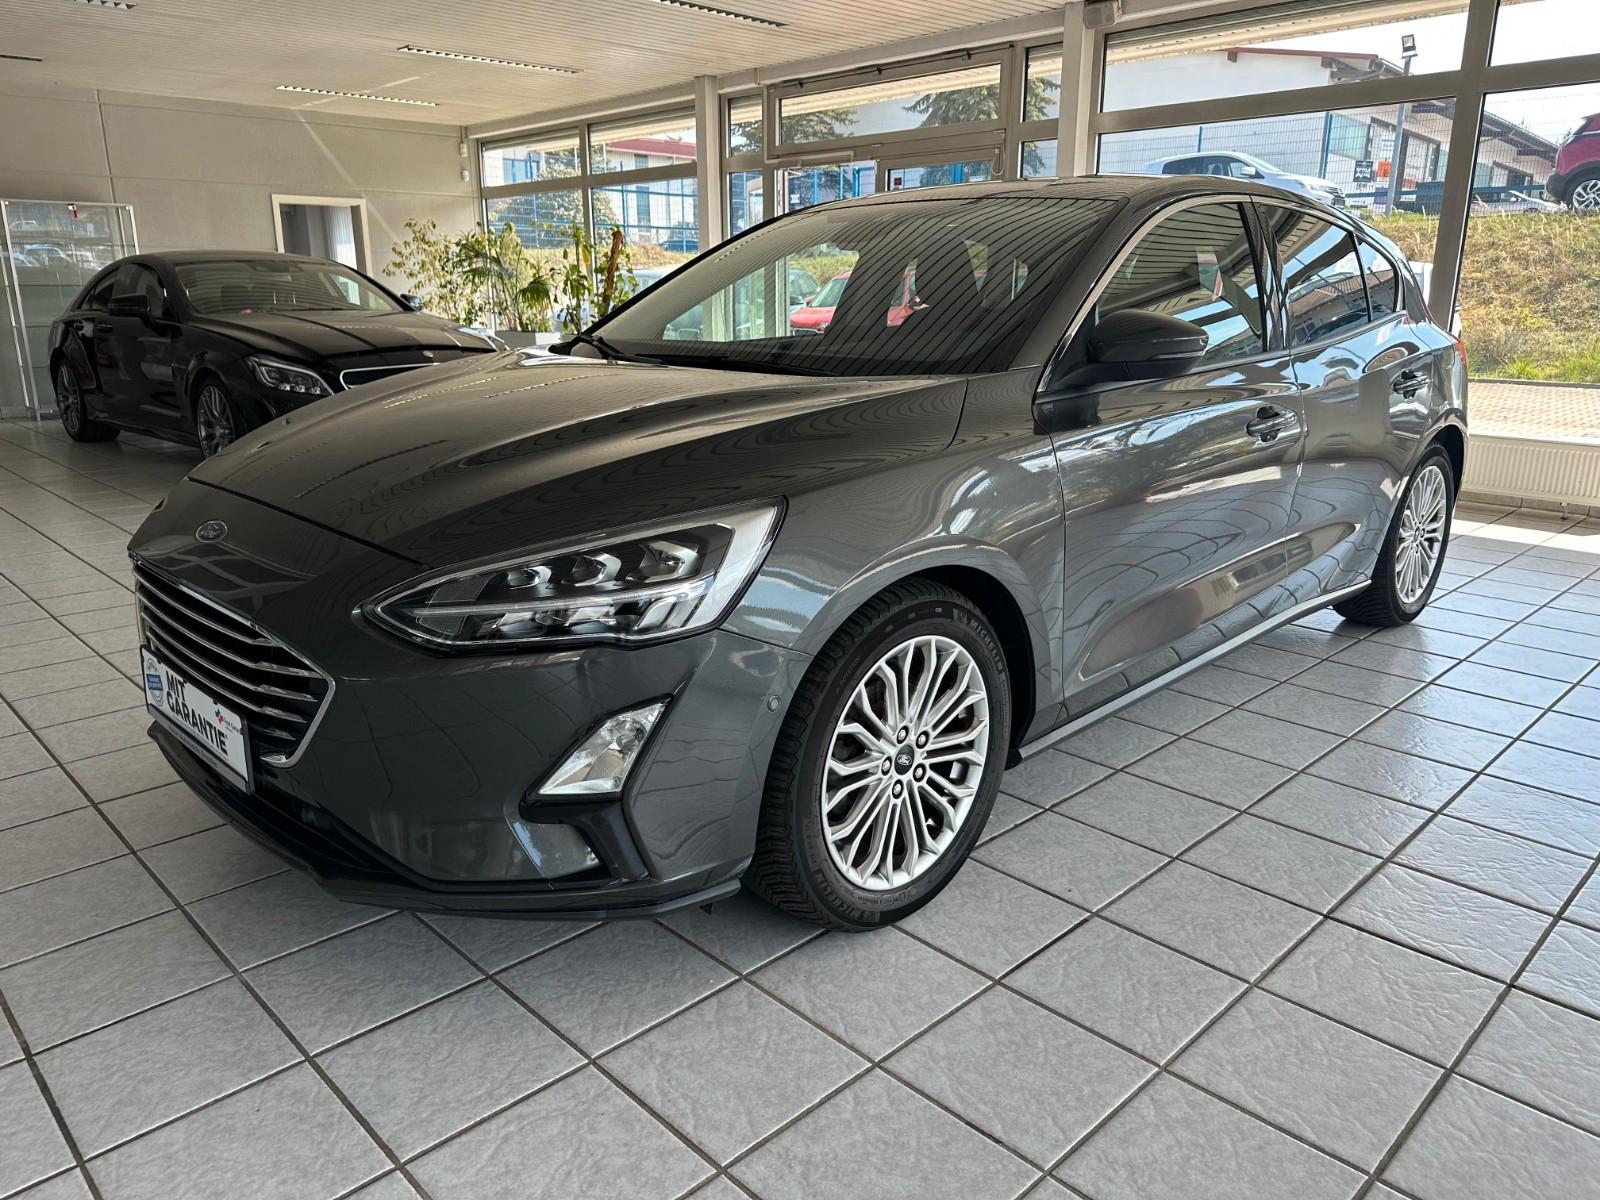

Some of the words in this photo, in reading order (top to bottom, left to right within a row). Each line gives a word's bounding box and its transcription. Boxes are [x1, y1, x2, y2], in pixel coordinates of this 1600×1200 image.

[968, 618, 1004, 673] MICHELIN
[165, 670, 185, 701] MIT
[166, 692, 229, 756] GARANTIE
[815, 869, 866, 921] MICHELIN
